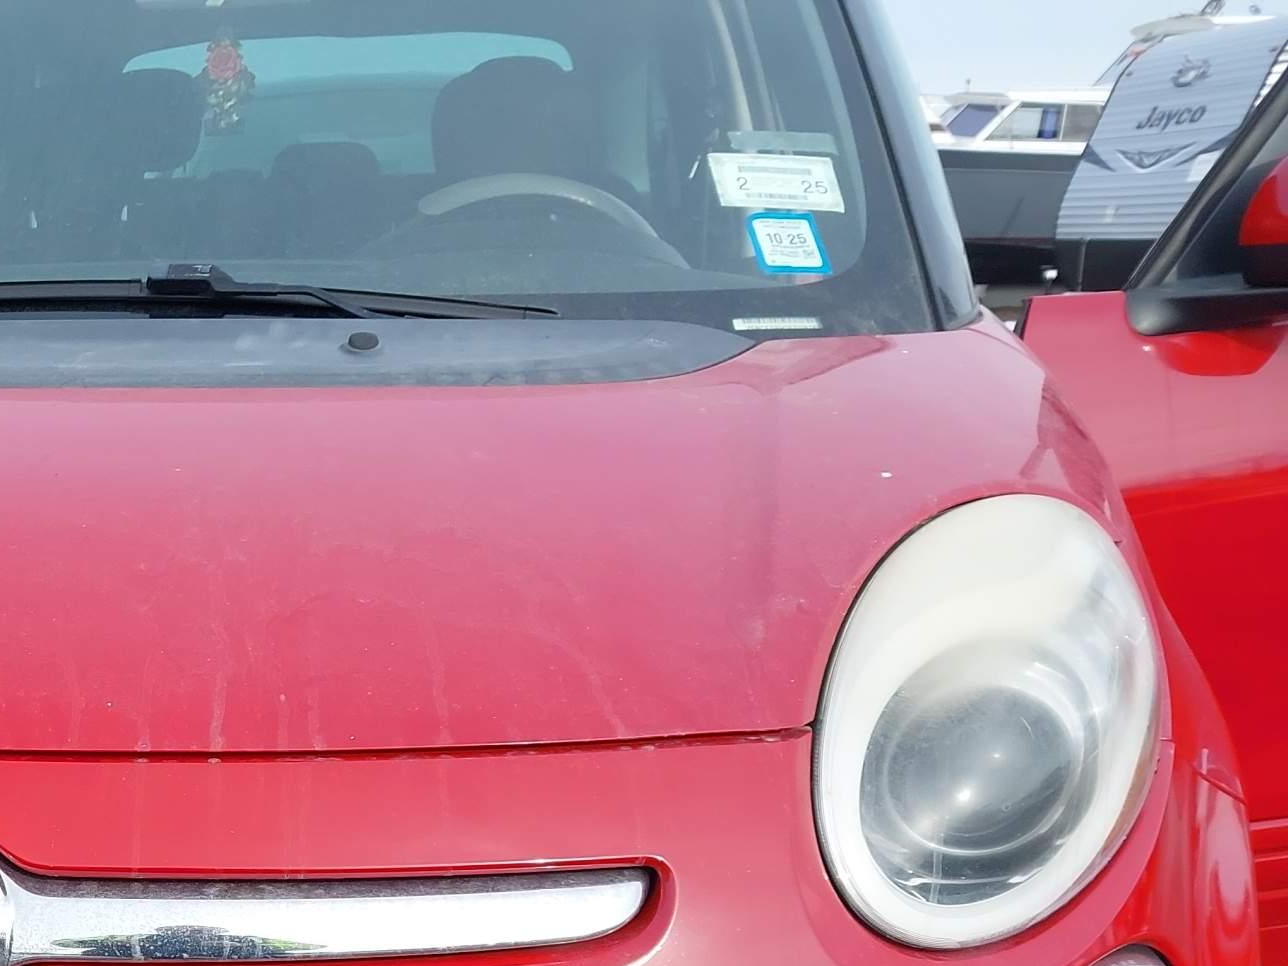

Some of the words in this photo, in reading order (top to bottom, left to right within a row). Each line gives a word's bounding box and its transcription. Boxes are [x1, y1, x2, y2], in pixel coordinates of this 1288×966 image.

[1135, 105, 1207, 132] Jayco
[736, 176, 751, 191] 2
[801, 180, 828, 194] 25
[765, 232, 783, 245] 10
[786, 233, 807, 245] 25
